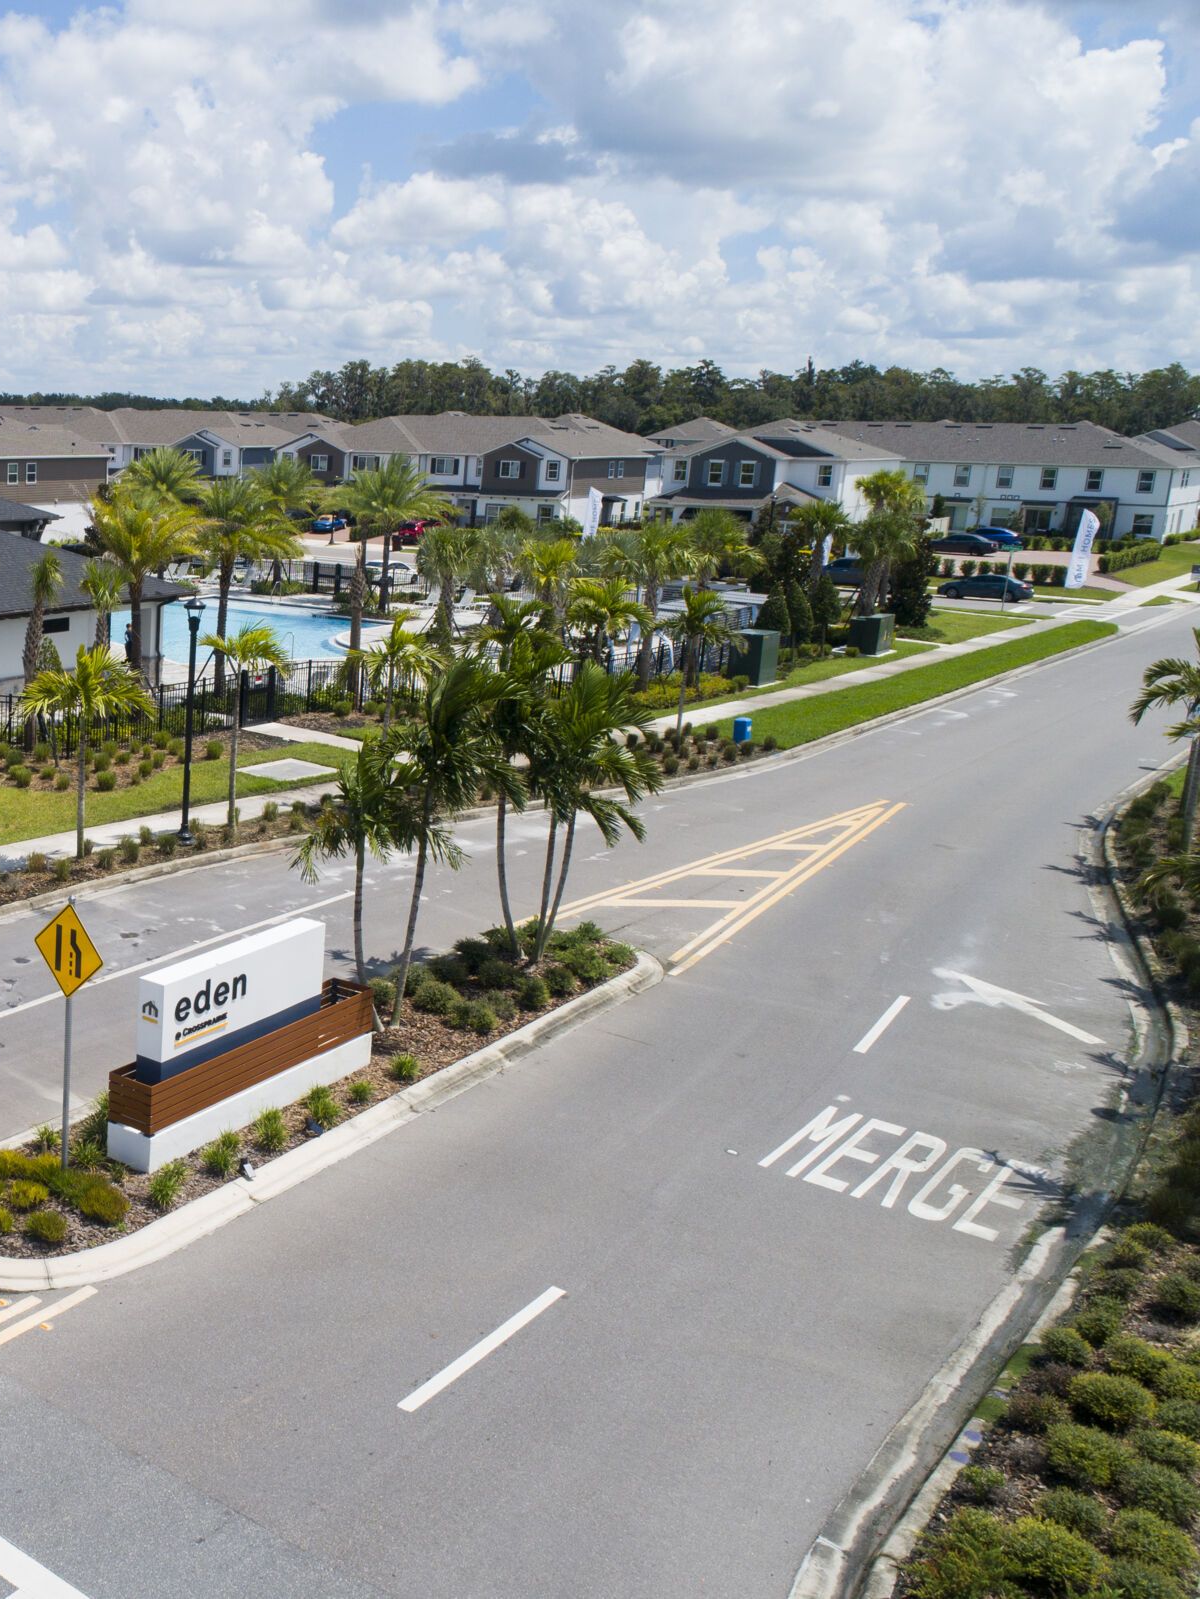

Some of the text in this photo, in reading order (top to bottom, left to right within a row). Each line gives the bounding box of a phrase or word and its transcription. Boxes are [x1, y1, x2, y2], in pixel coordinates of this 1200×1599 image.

[1082, 518, 1095, 552] HOMES
[175, 973, 247, 1022] eden
[757, 1105, 1050, 1242] MERGE
